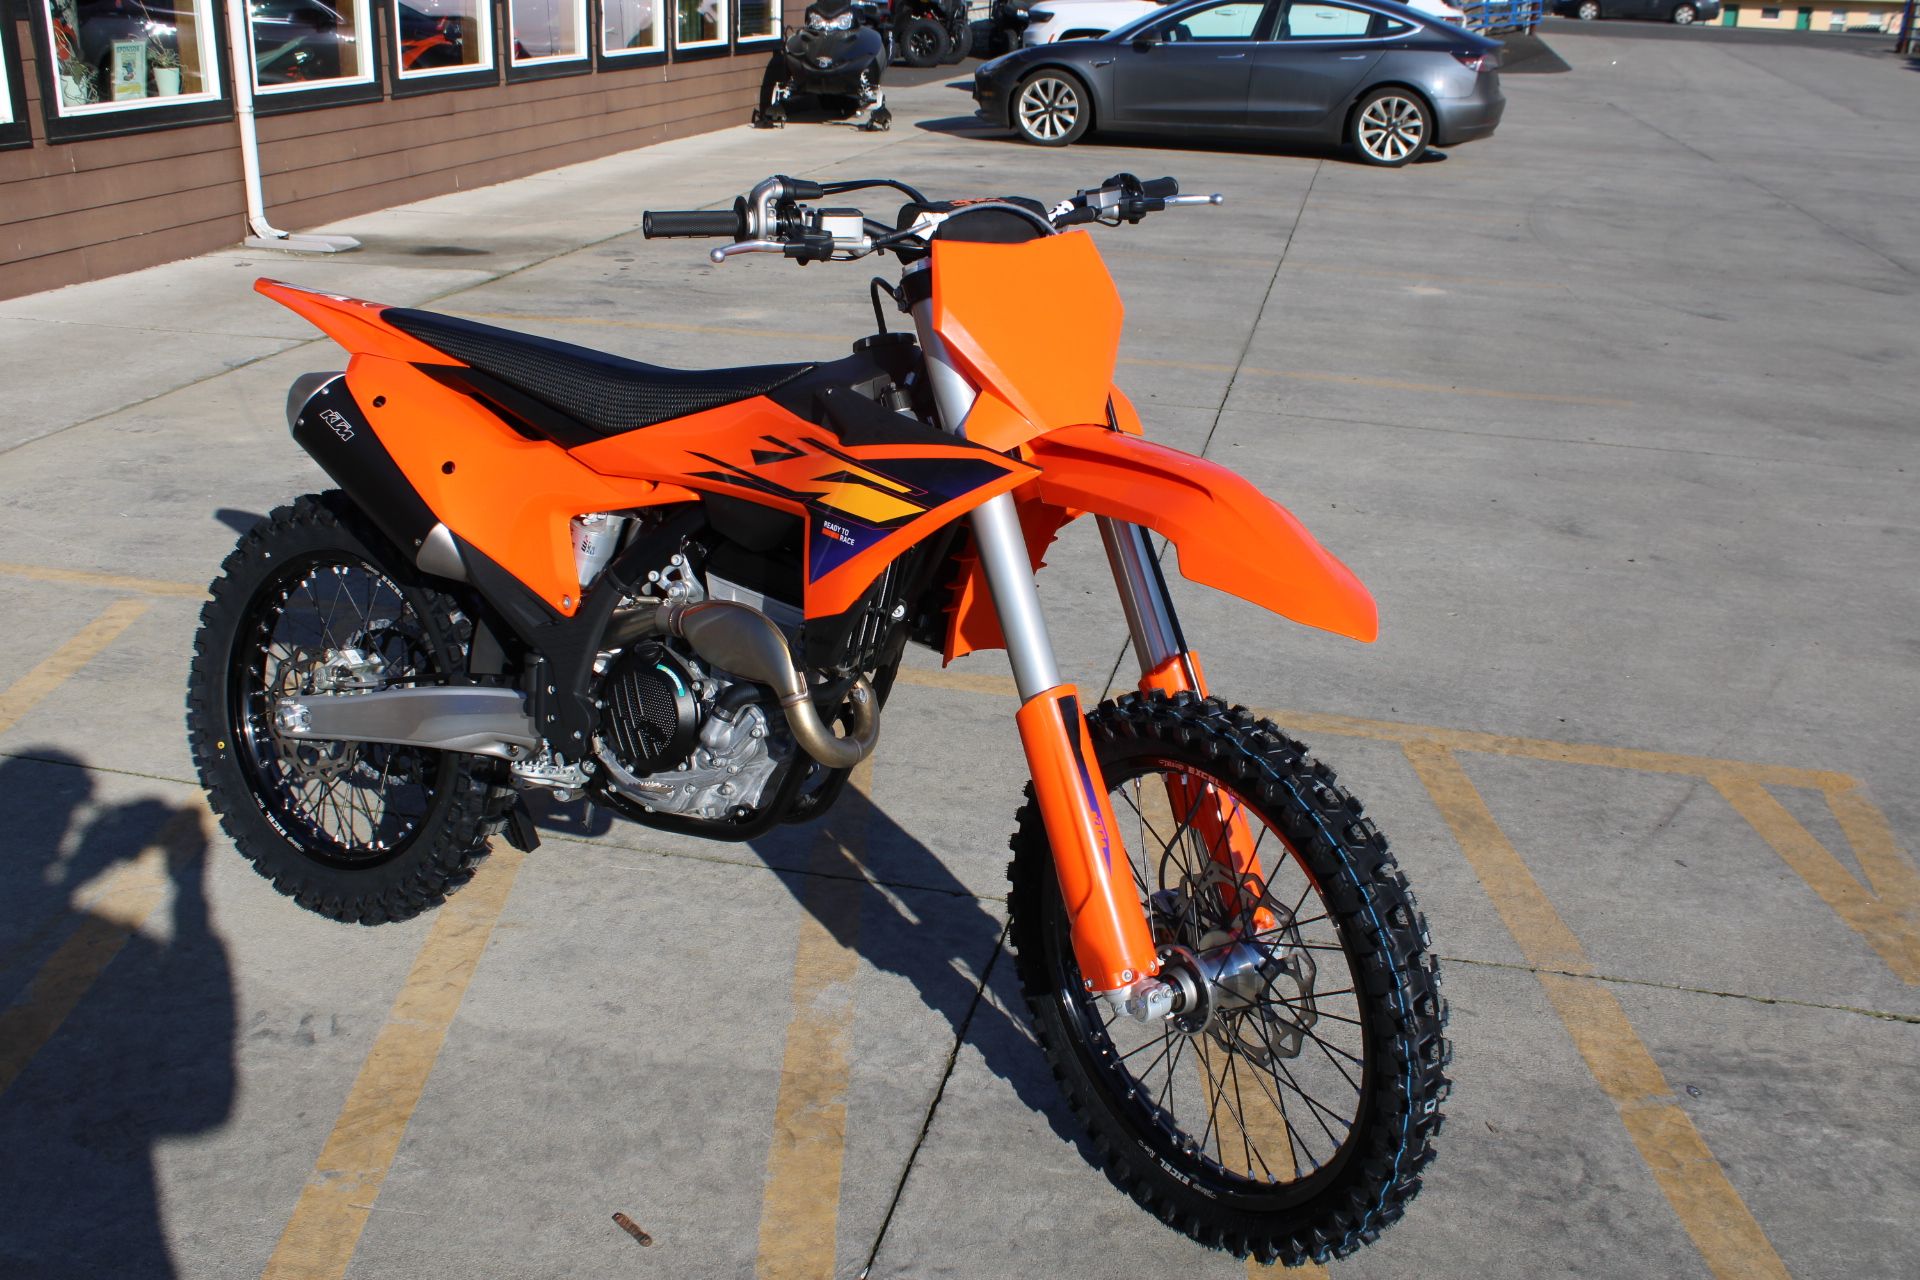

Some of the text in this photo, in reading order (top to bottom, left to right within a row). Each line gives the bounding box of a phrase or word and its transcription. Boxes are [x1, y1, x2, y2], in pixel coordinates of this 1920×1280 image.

[319, 408, 355, 442] KTM
[823, 520, 850, 537] READY TO
[839, 534, 855, 546] RACE
[381, 574, 404, 600] EXCEL
[265, 810, 288, 837] EXCEL
[1159, 1157, 1191, 1187] EXCEL
